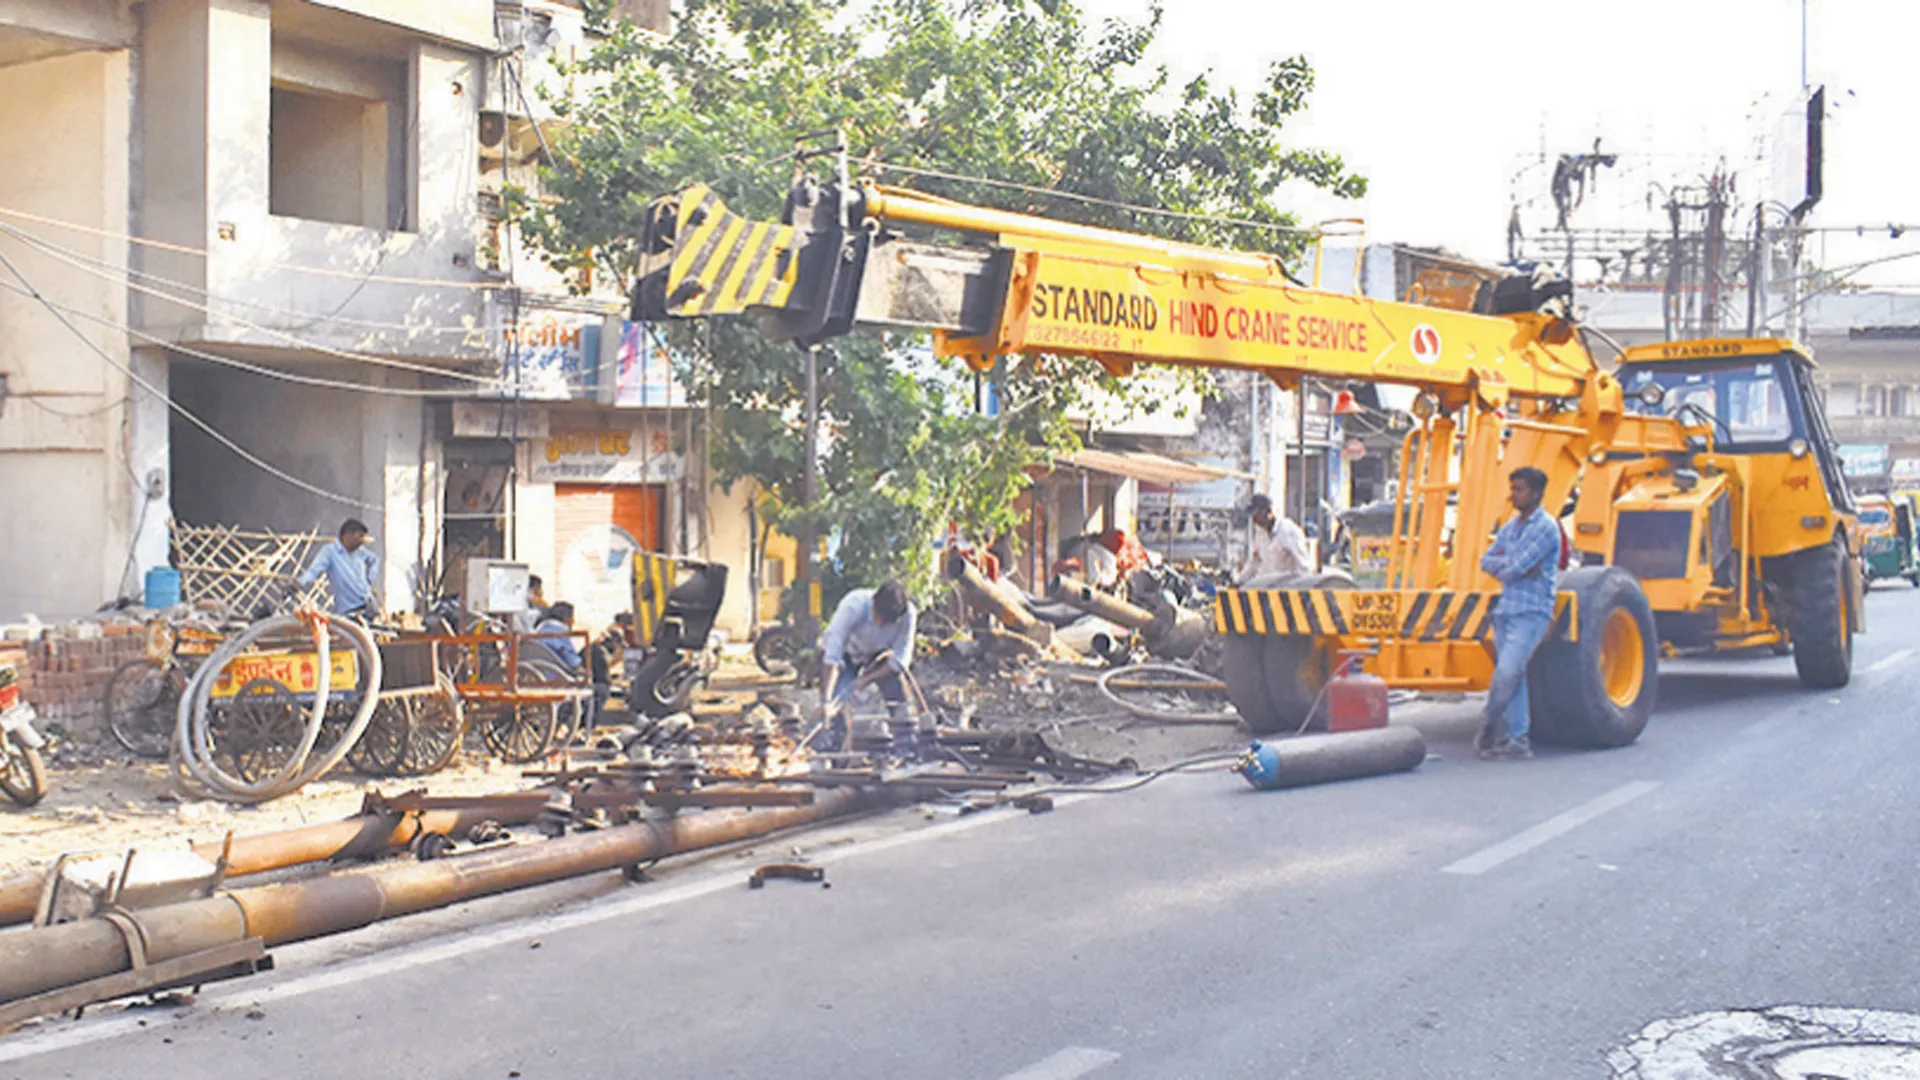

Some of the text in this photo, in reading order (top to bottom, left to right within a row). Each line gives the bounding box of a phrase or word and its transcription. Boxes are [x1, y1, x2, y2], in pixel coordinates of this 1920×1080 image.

[1031, 282, 1368, 353] STANDARD HIND CRANE SERVICE
[1661, 343, 1743, 358] STANDARD
